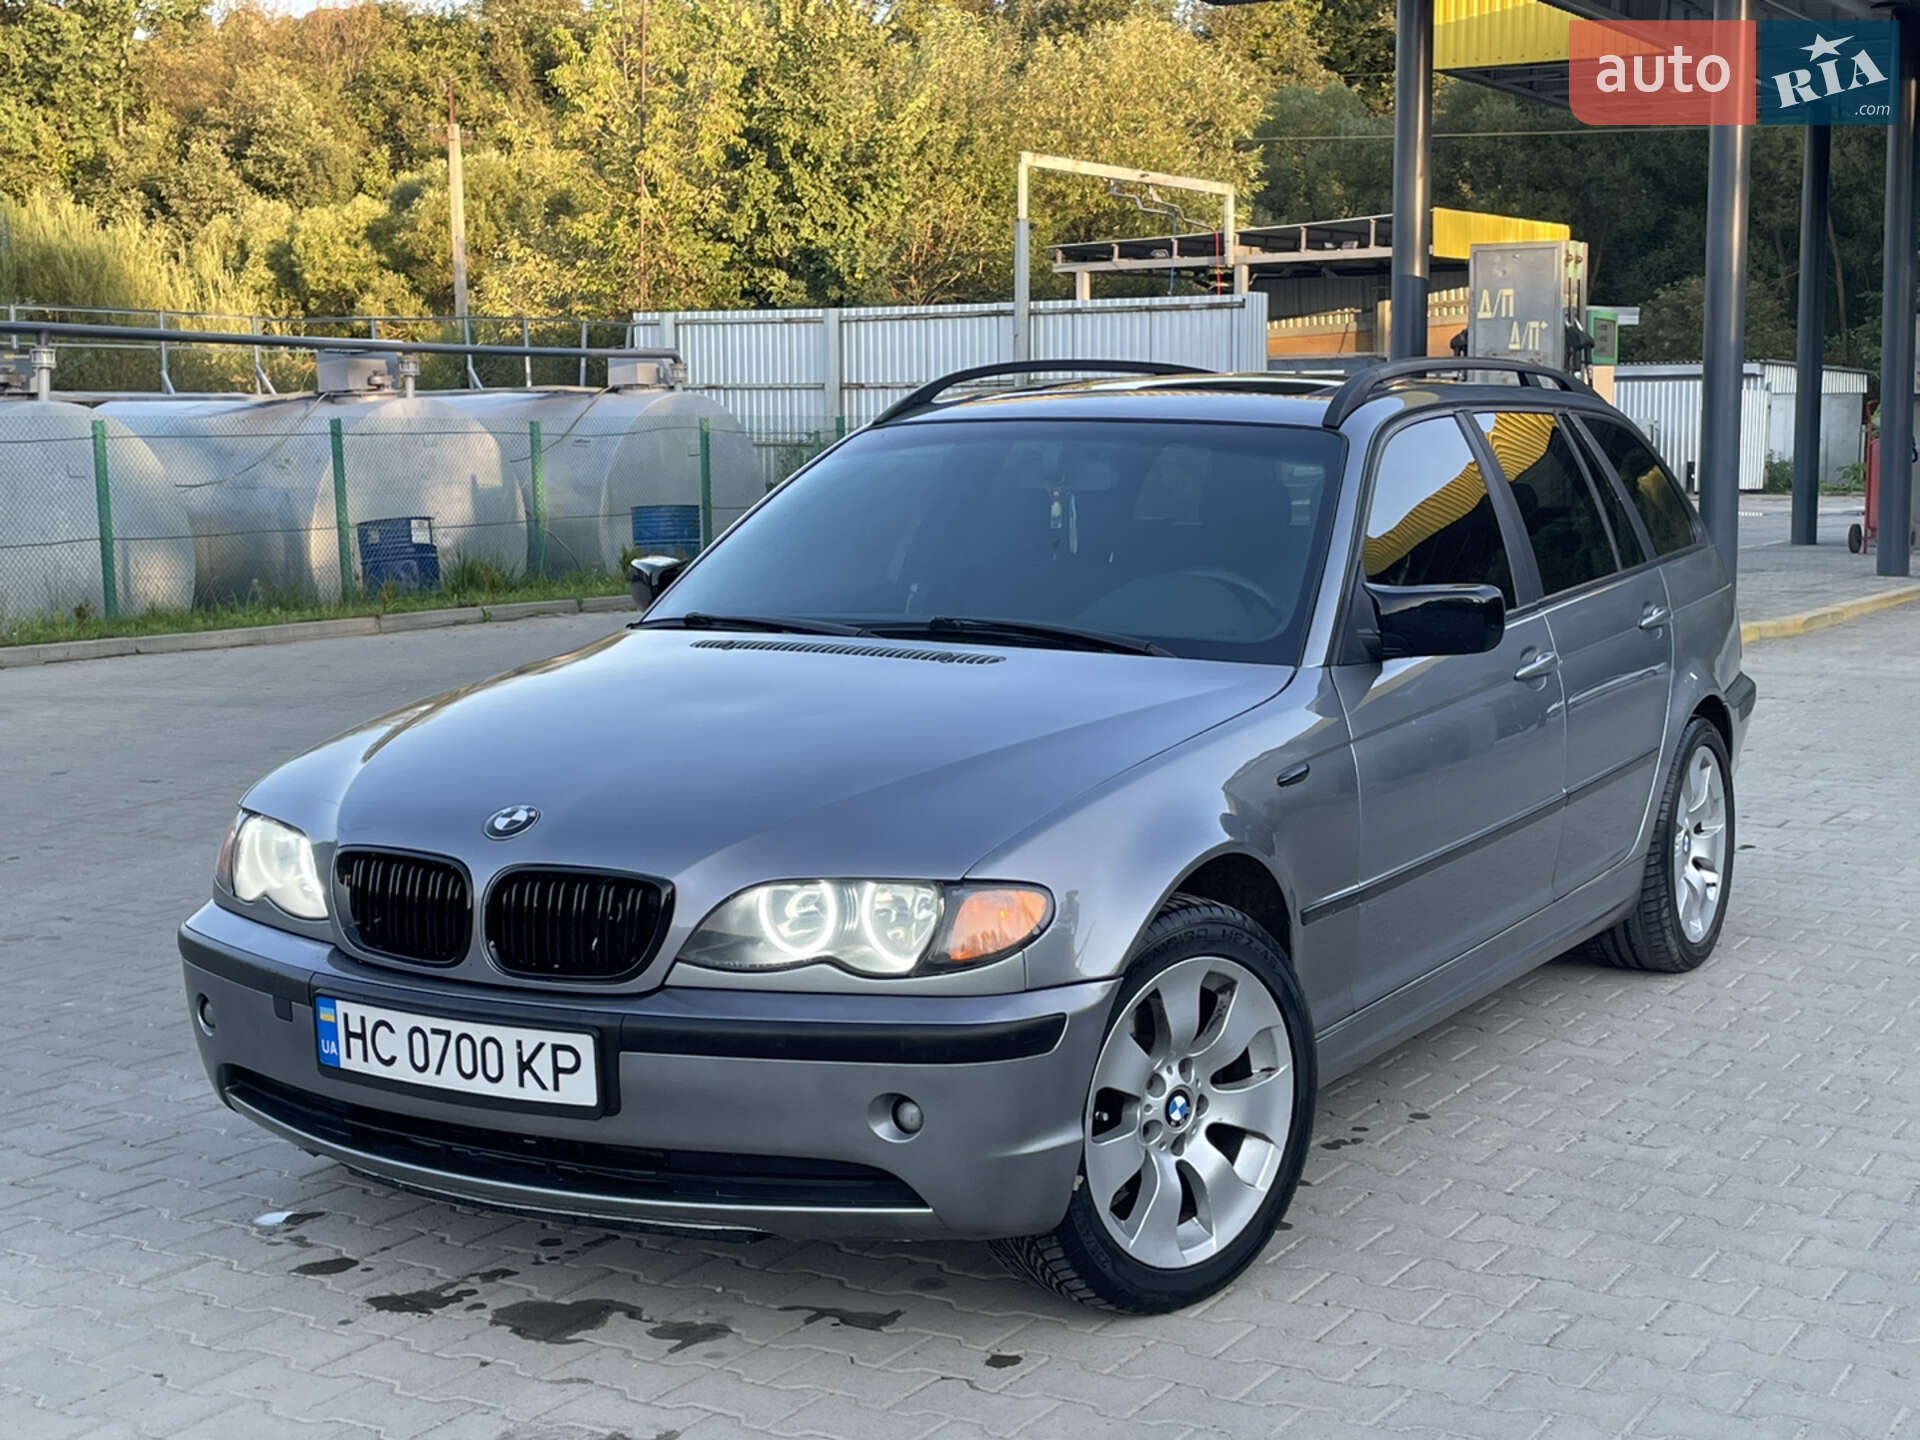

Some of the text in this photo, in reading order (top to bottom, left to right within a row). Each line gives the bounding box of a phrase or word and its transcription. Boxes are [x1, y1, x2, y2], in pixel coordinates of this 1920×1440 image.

[320, 1039, 338, 1056] UA
[342, 1012, 582, 1092] HC 0700 KP
